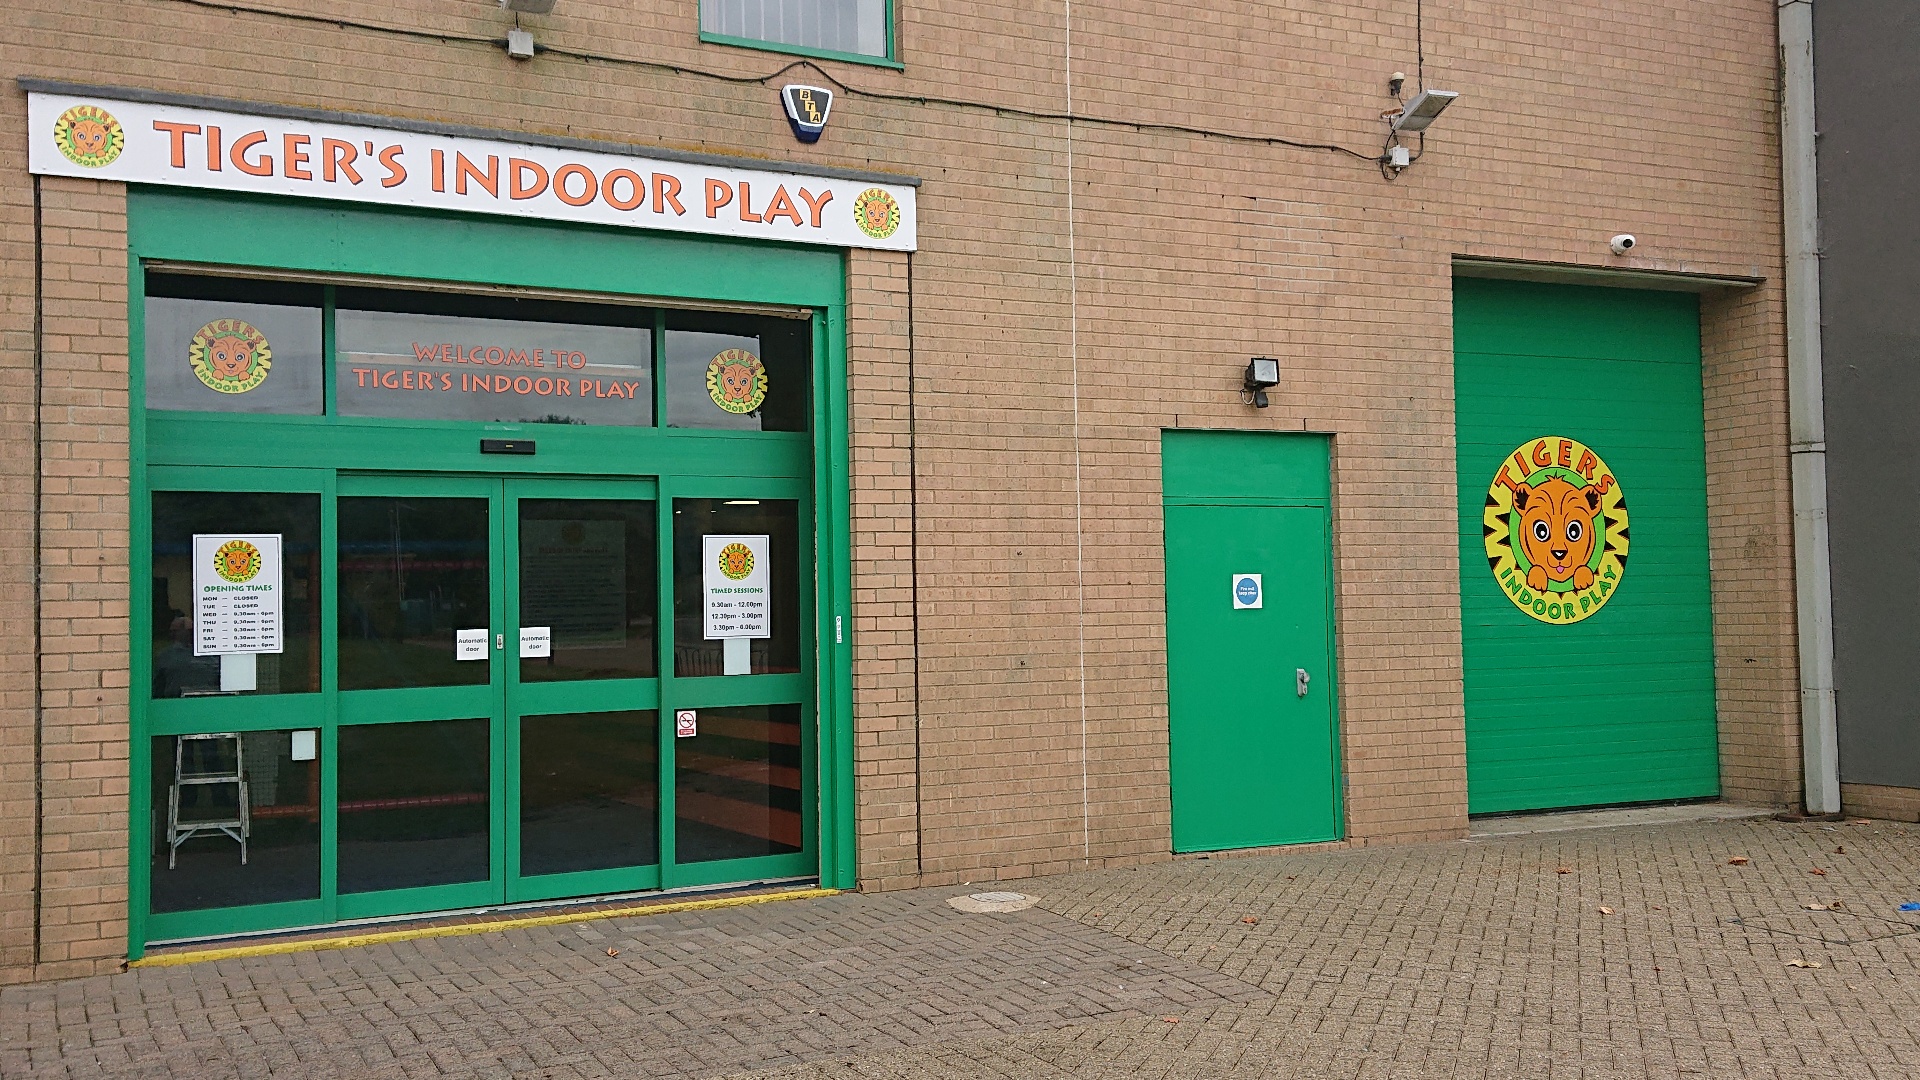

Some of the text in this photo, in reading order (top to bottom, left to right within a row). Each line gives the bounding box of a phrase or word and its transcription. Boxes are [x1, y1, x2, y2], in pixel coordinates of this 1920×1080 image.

[60, 106, 118, 127] TIGERS
[62, 146, 118, 166] INDOOR PLAY
[153, 120, 834, 228] TIGER'S INDOOR PLAY
[196, 320, 265, 345] TIGERS
[412, 342, 587, 369] WELCOME TO
[711, 349, 762, 370] TIGERS
[198, 369, 264, 392] INDOOR PLAY
[352, 368, 640, 399] TIGER'S INDOOR PLAY
[713, 393, 763, 412] INDOOR PLAY
[1494, 440, 1616, 495] TIGERS
[1500, 565, 1617, 619] INDOOR PLAY
